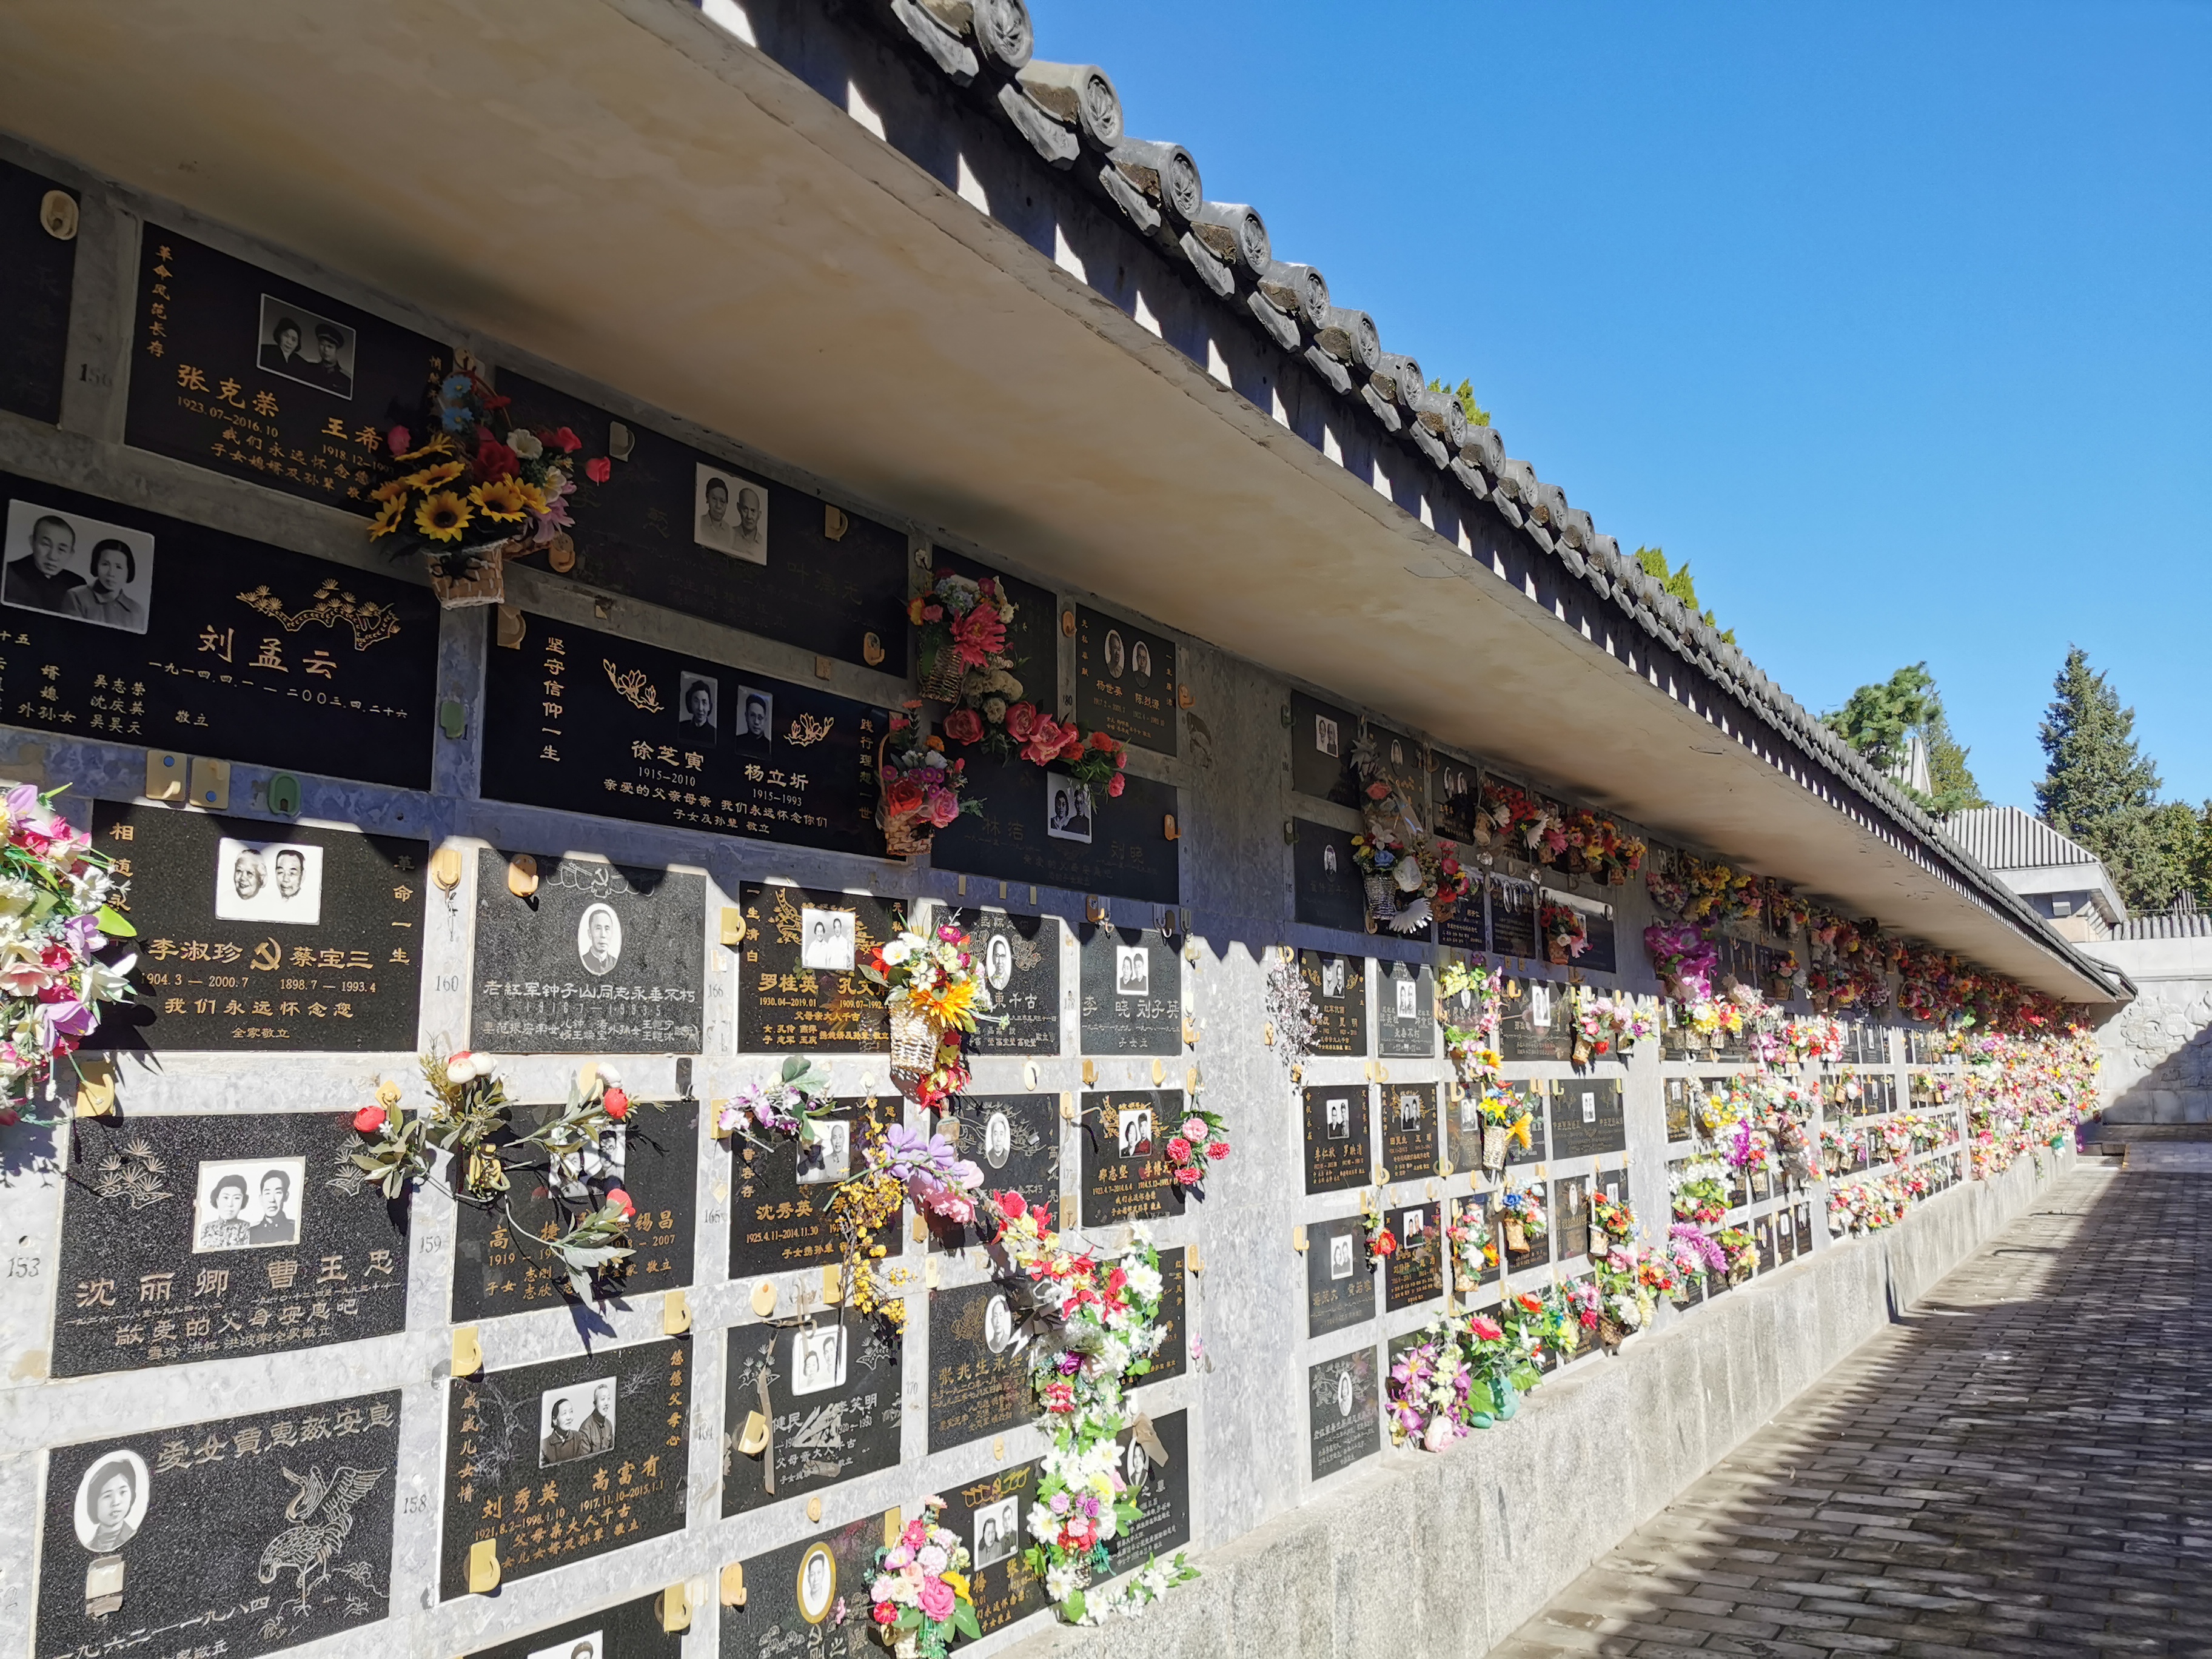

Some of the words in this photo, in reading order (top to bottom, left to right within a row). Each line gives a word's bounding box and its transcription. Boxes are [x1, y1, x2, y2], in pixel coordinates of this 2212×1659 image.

[147, 245, 173, 358] 革命风范长存
[176, 364, 280, 418] 张克荣
[222, 427, 370, 486] 我们永远怀念您
[197, 625, 338, 679] 刘孟云
[93, 674, 146, 697] 吴志荣
[1096, 680, 1123, 698] 杨世英
[90, 695, 145, 716] 沈庆英
[540, 637, 566, 762] 坚守信仰一生
[18, 702, 76, 723] 外孙女
[175, 709, 209, 728] 敬立
[631, 740, 704, 773] 徐芝寅
[603, 777, 712, 809] 亲爱的父亲母亲
[721, 798, 828, 828] 我们永远怀念你们
[388, 854, 415, 965] 革命一生
[746, 888, 760, 963] 一生清白
[148, 937, 244, 964] 李淑珍
[289, 946, 374, 970] 蔡宝三
[435, 974, 459, 993] 160
[758, 973, 819, 994] 罗桂英
[164, 998, 355, 1019] 我们永远怀念您
[794, 1011, 860, 1022] 父母亲大人千古
[1137, 999, 1180, 1019] 刘子英
[231, 1027, 290, 1039] 全家敬立
[756, 1200, 813, 1221] 沈秀英
[418, 1235, 443, 1255] 159
[652, 1234, 676, 1247] 2007
[6, 1256, 40, 1279] 153
[646, 1257, 672, 1273] 敬立
[75, 1269, 230, 1309] 沈丽卿
[485, 1279, 517, 1297] 子女
[115, 1298, 360, 1346] 敬爱的父母安息吧
[666, 1349, 685, 1447] 悠悠父母心
[481, 1480, 559, 1520] 刘秀英
[592, 1455, 661, 1492] 高富有
[514, 1503, 631, 1547] 父母亲大人千古
